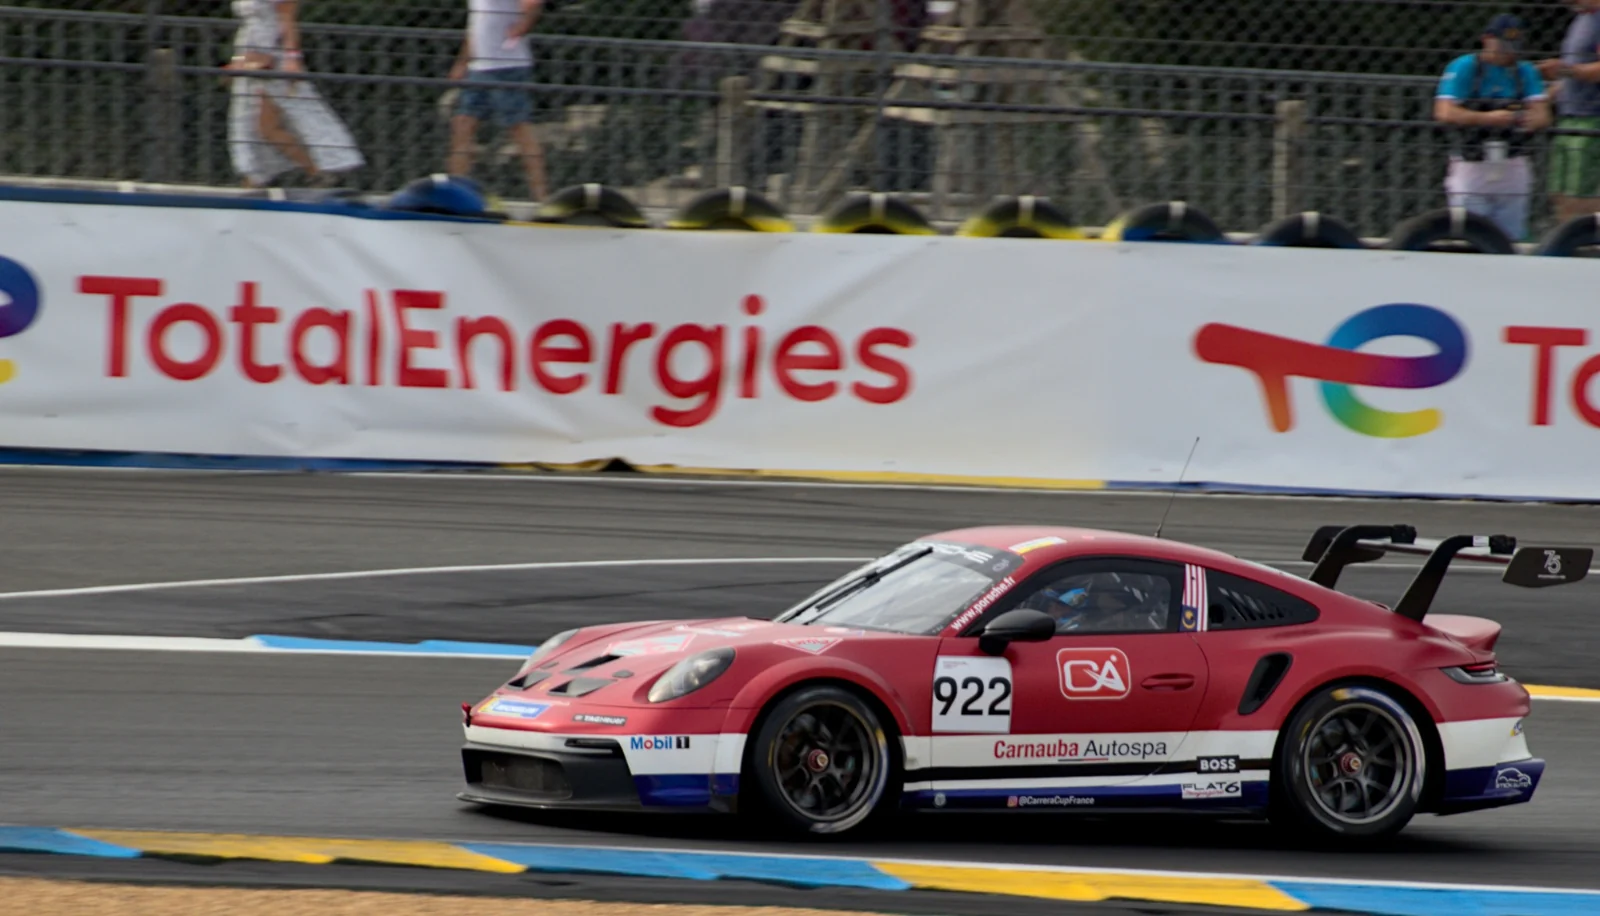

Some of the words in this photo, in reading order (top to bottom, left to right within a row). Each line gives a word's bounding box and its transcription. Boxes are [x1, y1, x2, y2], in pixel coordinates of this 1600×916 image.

[76, 275, 915, 428] TotalEnergies
[950, 576, 1016, 631] www.porsche.fr
[934, 676, 1011, 716] 922
[630, 736, 672, 750] Mobil
[993, 739, 1079, 759] Carnauba
[1084, 740, 1168, 759] Autospa
[1200, 758, 1237, 770] BOSS
[1019, 795, 1095, 807] @CarreraCupFrance
